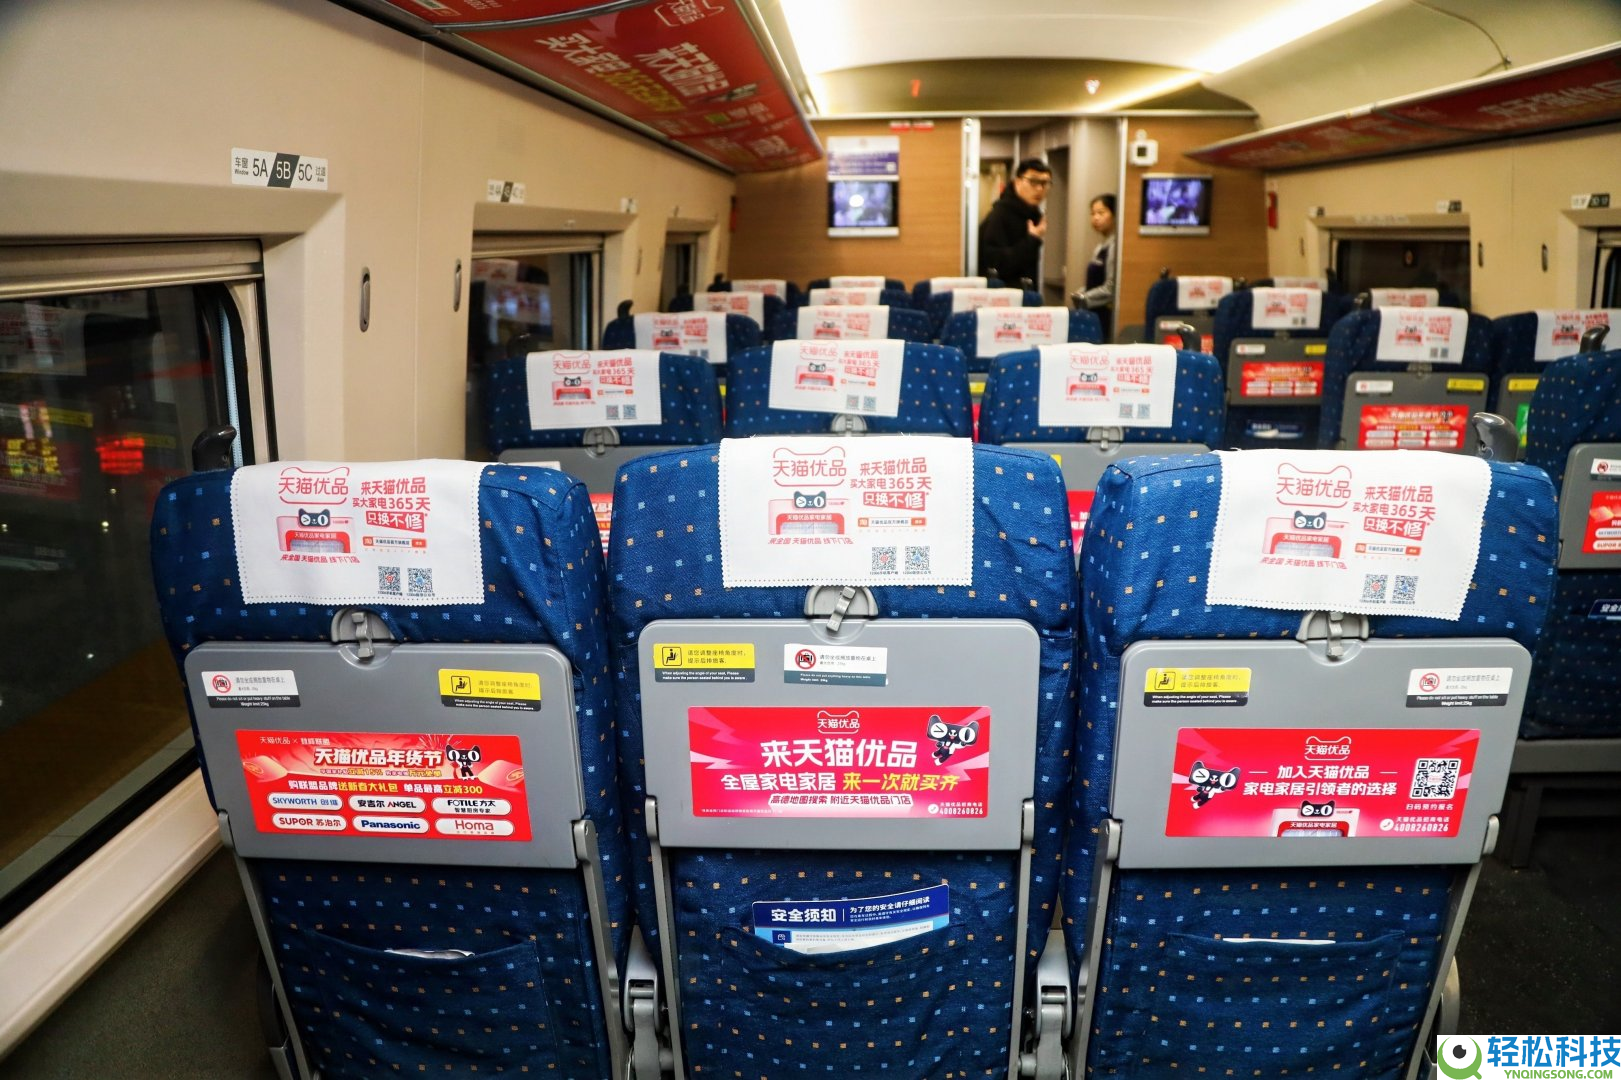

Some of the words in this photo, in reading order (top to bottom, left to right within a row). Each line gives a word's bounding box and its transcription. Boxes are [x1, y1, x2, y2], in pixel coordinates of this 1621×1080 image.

[252, 158, 268, 177] 5A
[276, 161, 291, 179] 5B
[298, 164, 313, 181] 5C
[772, 460, 847, 478] 天猫优品
[860, 457, 927, 475] 来天猫优品
[278, 477, 349, 495] 天猫优品
[360, 477, 426, 495] 来天猫优品
[850, 476, 932, 490] 买大家电365天
[1276, 476, 1352, 499] 天猫优品
[864, 492, 925, 510] 只换不修
[1365, 485, 1434, 503] 来天猫优品
[352, 497, 431, 512] 买大家电365天
[1353, 502, 1436, 521] 买大家电365天
[367, 512, 424, 531] 只换不修
[1364, 518, 1425, 538] 只换不修
[817, 718, 860, 730] 天猫优品
[260, 737, 290, 745] 天猫优品
[315, 748, 442, 766] 天猫优品年货节
[760, 738, 917, 768] 来天猫优品
[1305, 744, 1351, 756] 天猫优品
[1277, 765, 1369, 780] 加入天猫优品
[288, 780, 398, 793] 购联盟品牌送新春大礼包
[404, 783, 483, 795] 单品最高立减300
[721, 773, 837, 791] 全屋家电家居
[843, 774, 960, 791] 来一次就买齐
[1243, 782, 1397, 797] 家电家居引领者的选择
[272, 797, 317, 806] SKYWORTH
[358, 799, 384, 808] 安吉尔
[387, 800, 417, 809] ANGEL
[448, 799, 479, 807] FOTILE
[480, 799, 496, 807] 方太
[770, 794, 828, 805] 高德地图搜索
[830, 794, 912, 805] 附近天猫优品门店
[1405, 803, 1454, 811] 扫码预约报名
[939, 807, 984, 815] 4008260826
[279, 817, 313, 826] SUPOR
[361, 820, 421, 831] Panasonic
[455, 819, 494, 831] Homa
[1394, 823, 1449, 832] 4008260826
[849, 896, 930, 914] 为了您的安全请仔细阅读
[771, 908, 837, 923] 安全须知
